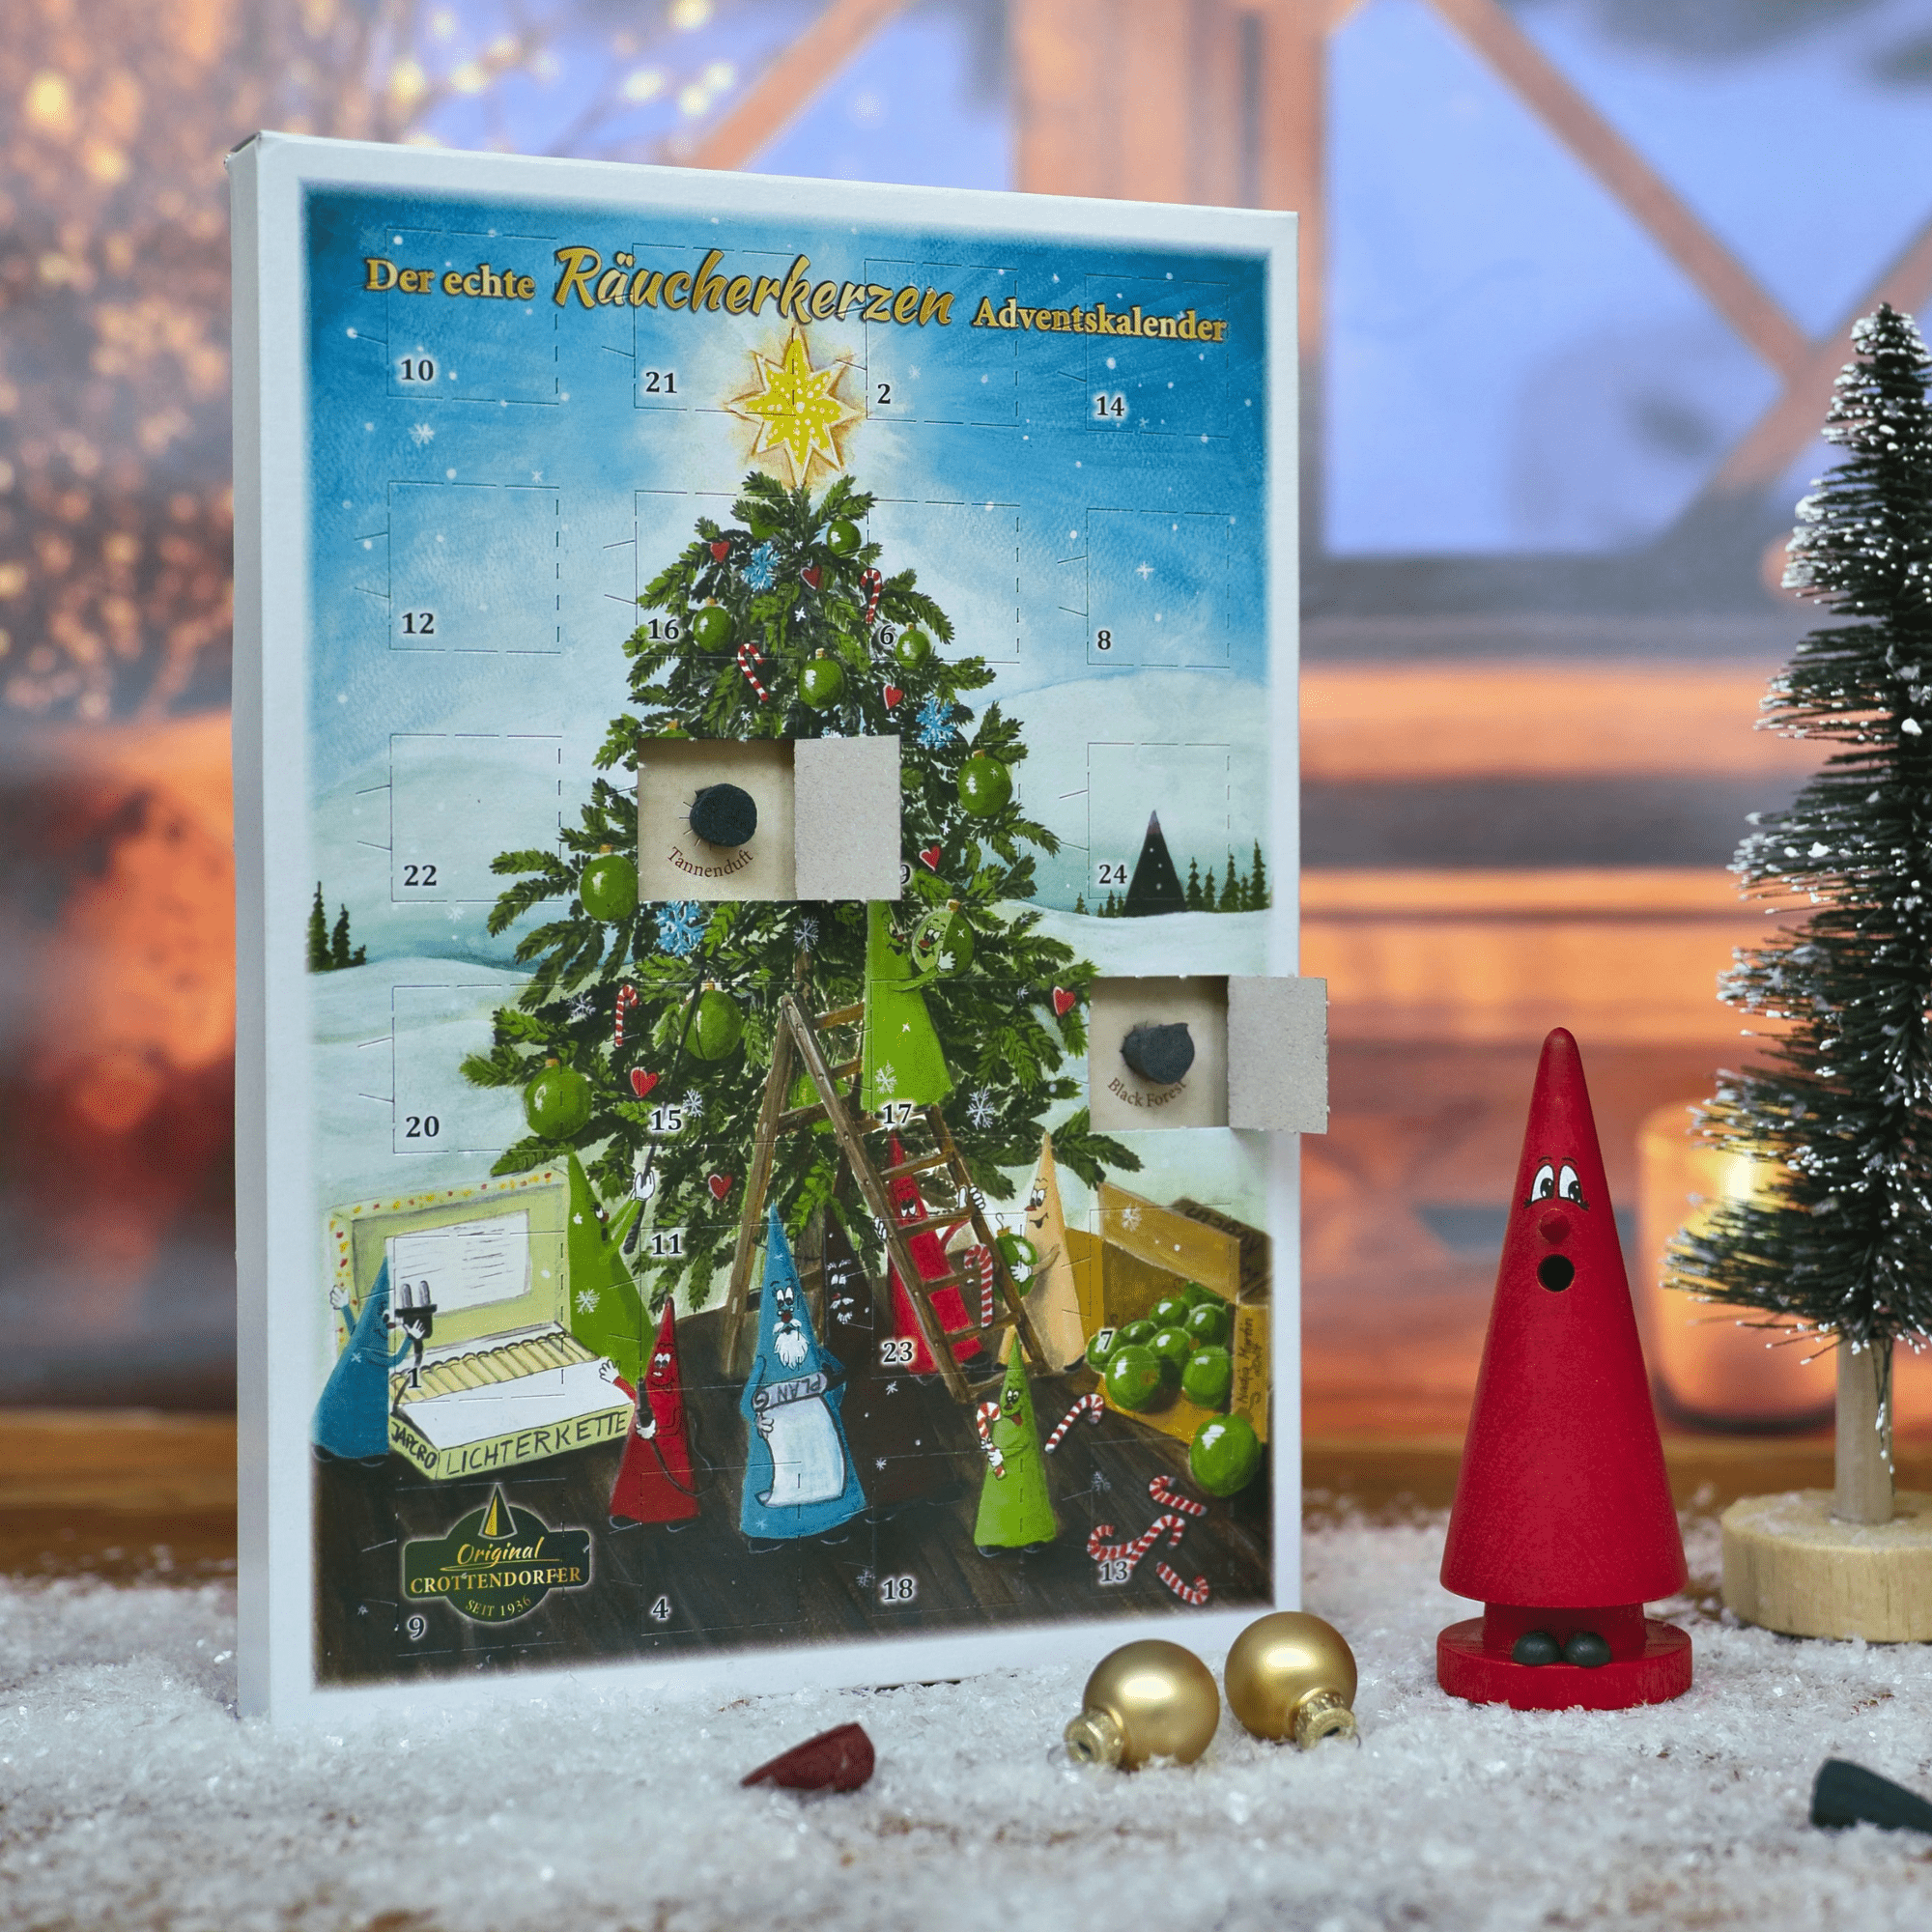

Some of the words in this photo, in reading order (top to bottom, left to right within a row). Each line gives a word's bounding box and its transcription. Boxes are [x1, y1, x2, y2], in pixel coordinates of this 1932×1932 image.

[365, 257, 435, 294] Der
[442, 264, 536, 299] echte
[553, 245, 955, 326] Räucherkerzen
[972, 297, 1227, 342] Adventskalender
[400, 358, 434, 382] 10
[645, 371, 678, 394] 21
[877, 384, 892, 404] 2
[1095, 396, 1124, 417] 14
[402, 612, 435, 635] 12
[648, 618, 679, 639] 16
[880, 625, 895, 645] 6
[1096, 630, 1112, 650] 8
[667, 846, 753, 878] Tannenduft
[404, 865, 438, 886] 22
[1098, 865, 1127, 884] 24
[1107, 1078, 1143, 1107] Black
[1147, 1080, 1187, 1108] Forest
[651, 1109, 682, 1131] 15
[883, 1103, 912, 1124] 17
[406, 1116, 440, 1138] 20
[651, 1234, 682, 1255] 11
[1099, 1331, 1113, 1350] 7
[883, 1342, 913, 1363] 23
[408, 1367, 422, 1388] 1
[777, 1374, 822, 1403] PLAN
[446, 1411, 628, 1475] LICHTERKETTE
[457, 1537, 545, 1567] Original
[410, 1567, 582, 1594] CROTTENDORFER
[1100, 1560, 1128, 1581] 13
[883, 1578, 913, 1601] 18
[466, 1599, 495, 1617] SEIT
[500, 1597, 532, 1617] 1936
[652, 1599, 669, 1619] 4
[408, 1617, 425, 1639] 9
